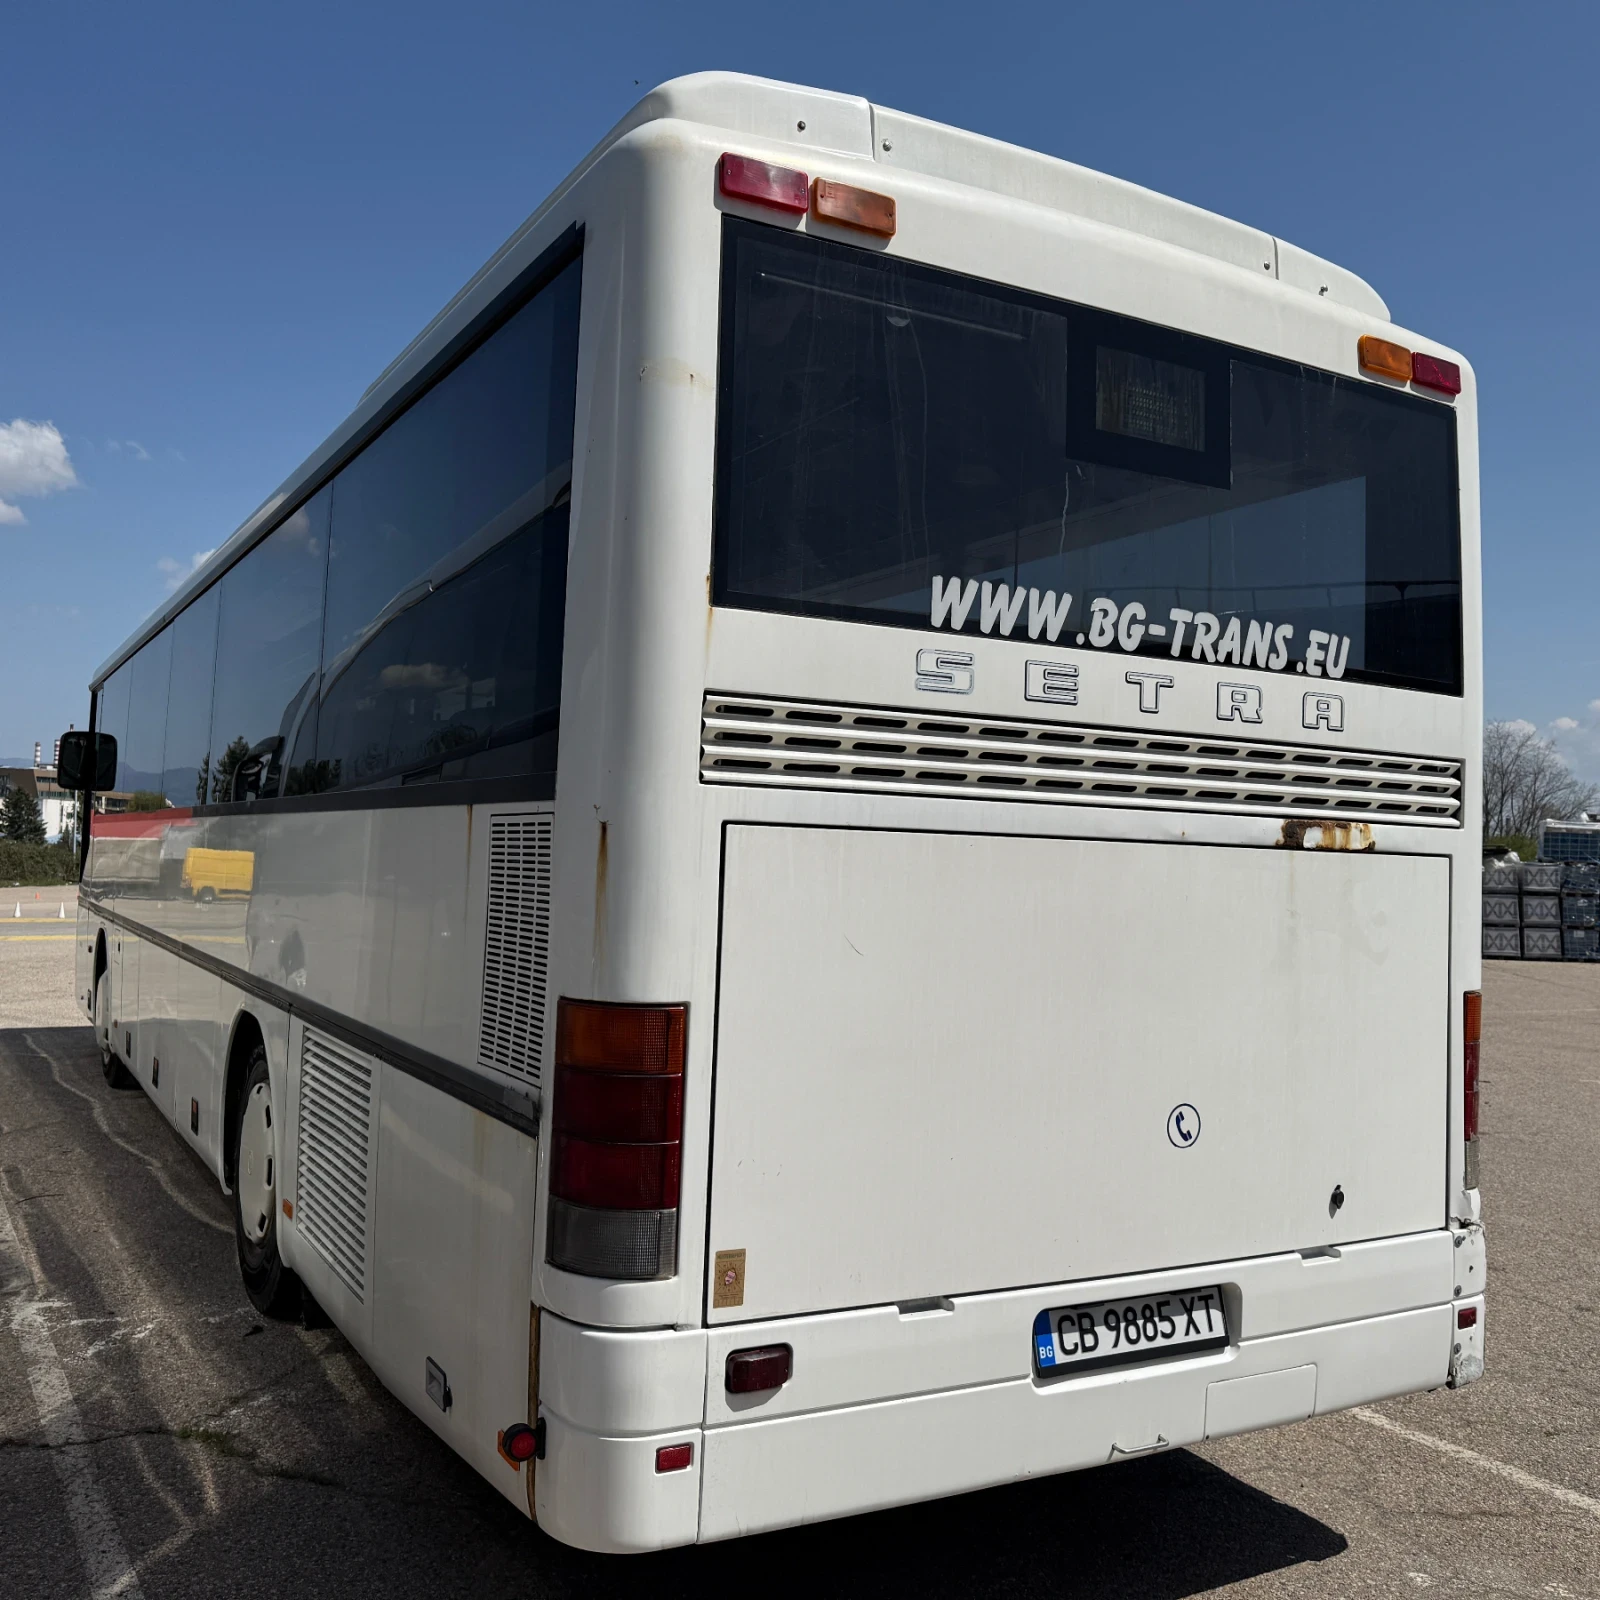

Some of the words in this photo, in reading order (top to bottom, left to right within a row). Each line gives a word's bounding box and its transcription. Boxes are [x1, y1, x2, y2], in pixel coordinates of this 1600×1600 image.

[931, 575, 1350, 678] WWW.BG-TRANS.EU
[915, 649, 1345, 731] SETRA
[1039, 1346, 1053, 1359] BG
[1057, 1312, 1099, 1355] CB
[1103, 1301, 1176, 1348] 9885
[1179, 1294, 1214, 1336] XT
